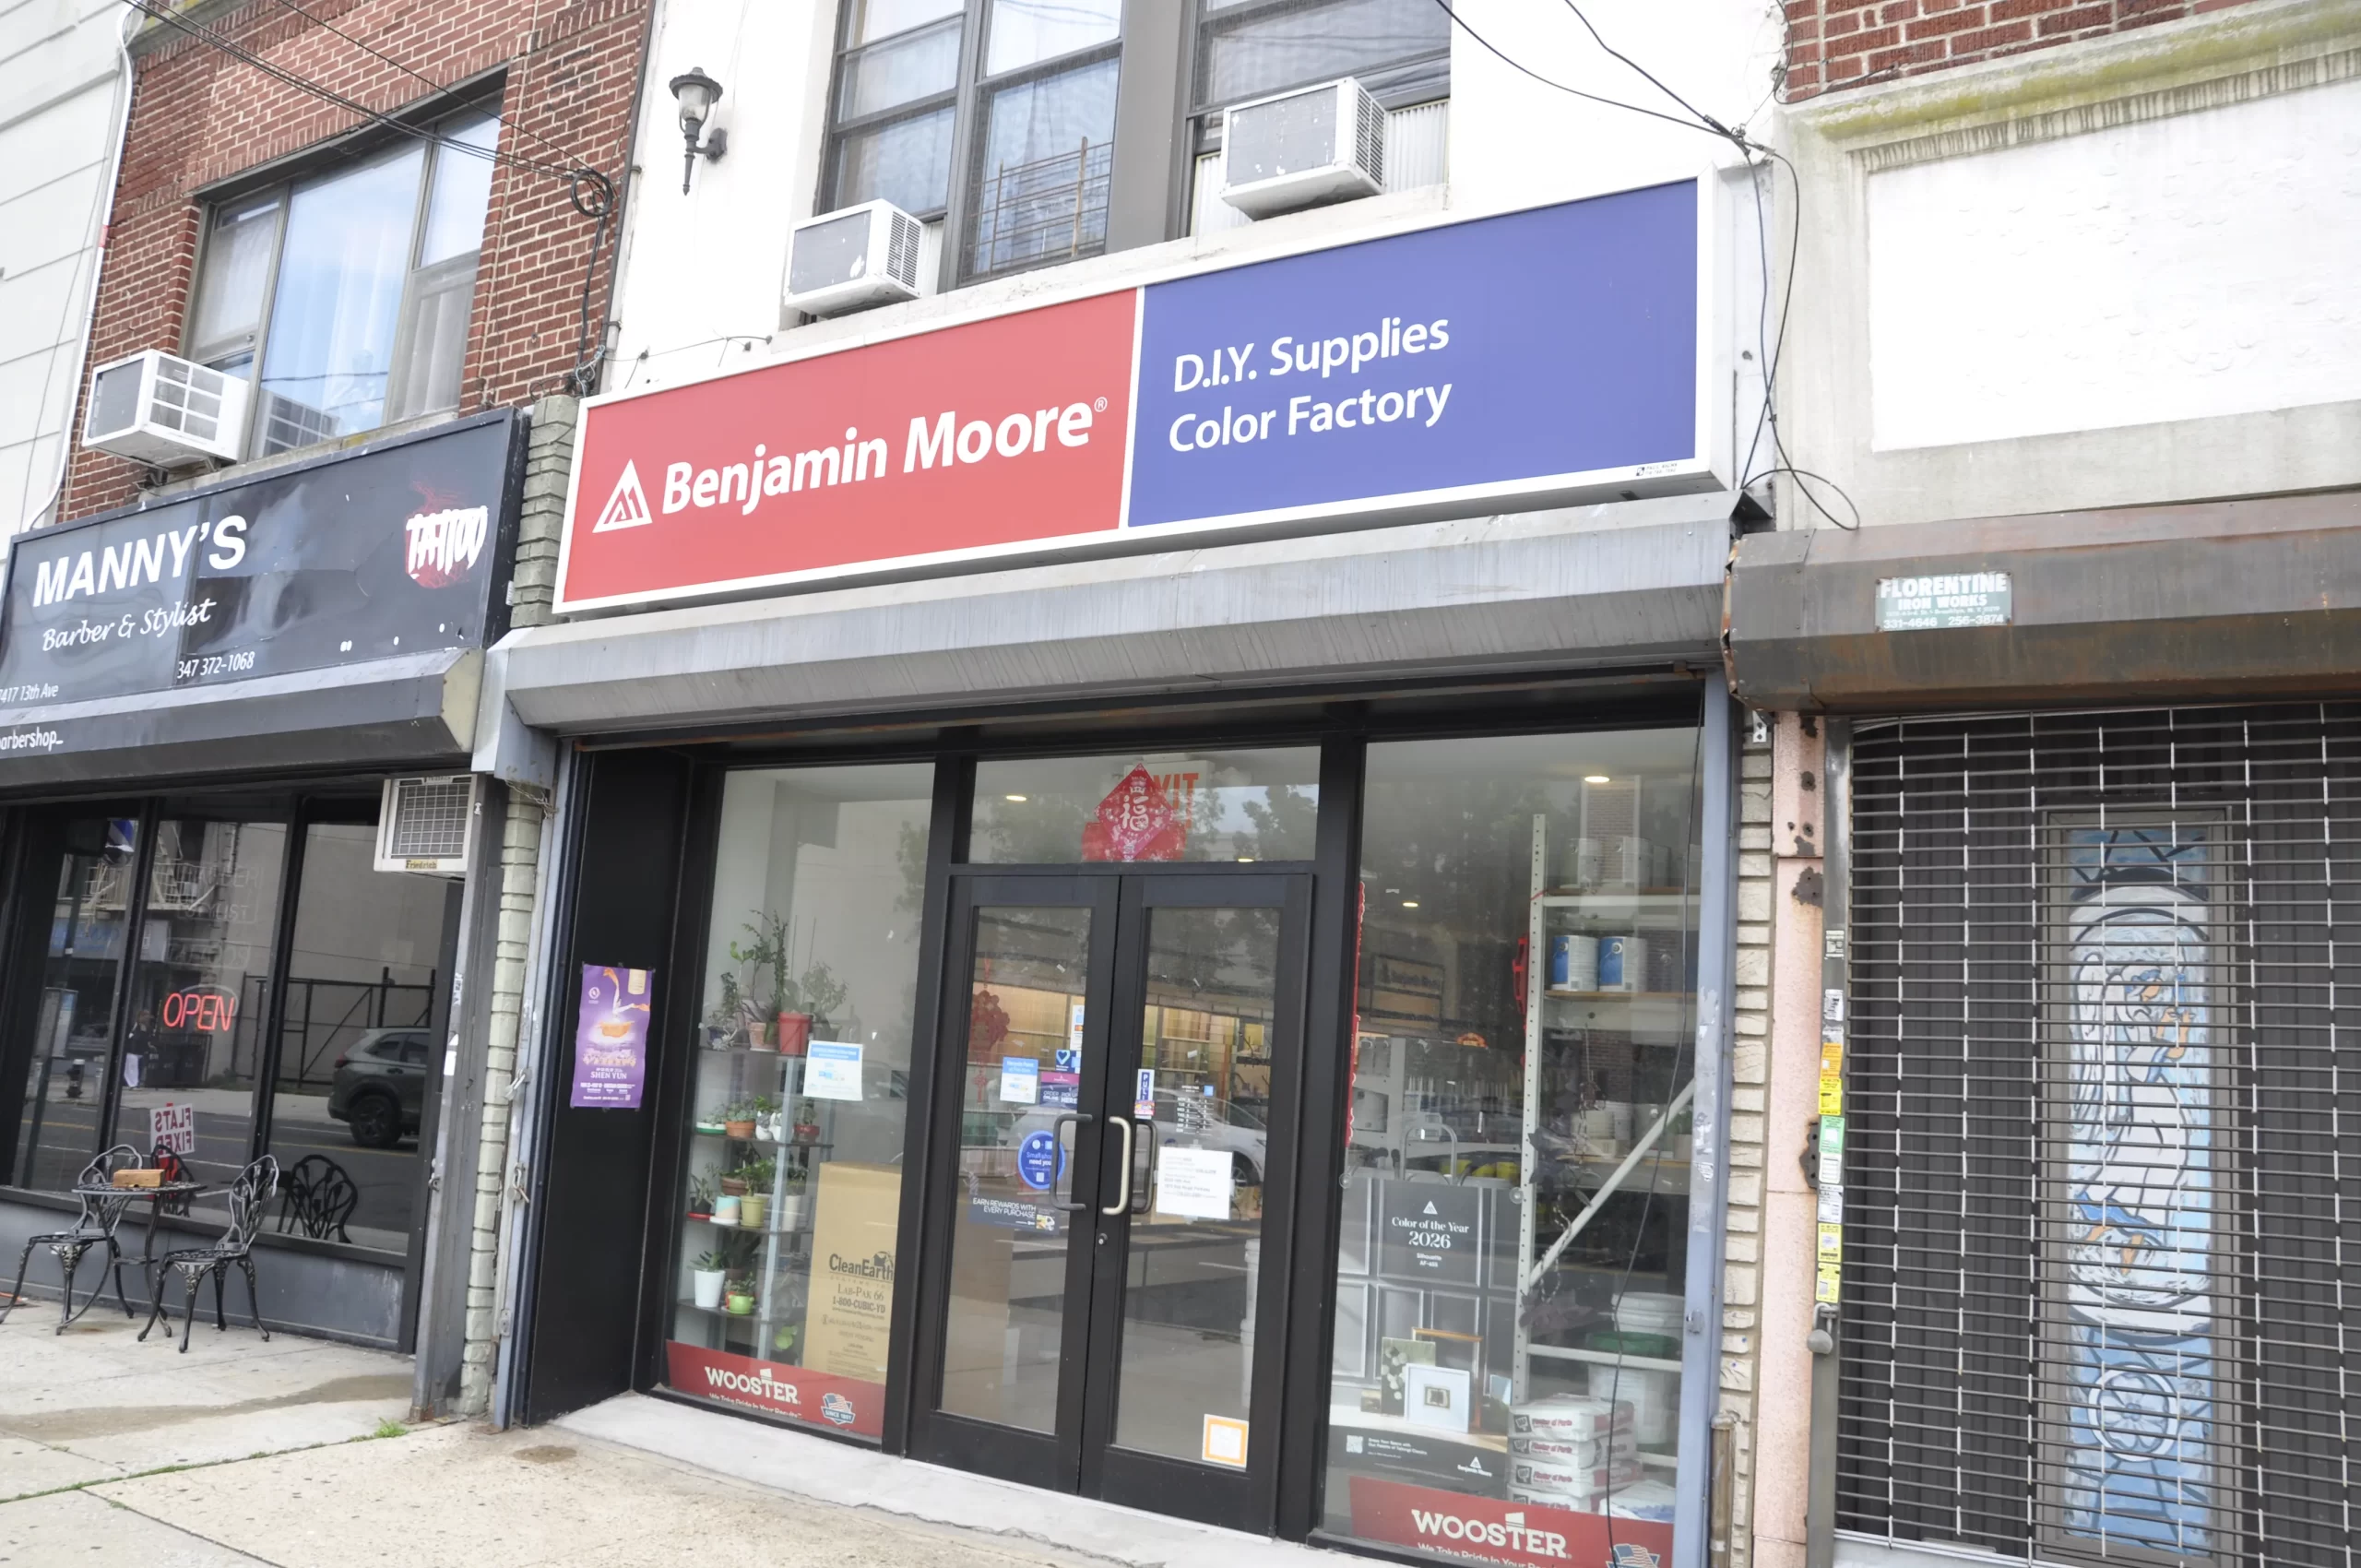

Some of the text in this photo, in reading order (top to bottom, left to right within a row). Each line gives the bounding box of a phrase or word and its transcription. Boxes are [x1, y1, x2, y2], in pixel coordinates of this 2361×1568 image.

[1173, 316, 1450, 393] D.I.Y. Supplies
[1169, 383, 1453, 453] Color Factory
[662, 427, 888, 515] Benjamin
[406, 505, 488, 577] TATTOO
[33, 515, 247, 608] MANNY'S
[1880, 572, 2008, 599] FLORENTINE
[1897, 594, 1987, 611] IRON WORKS
[42, 598, 218, 652] Barber & Stylist
[1883, 614, 2004, 629] 331-4646 256-3874
[176, 651, 255, 680] 347 372-1068
[19, 683, 40, 701] 13th
[40, 683, 59, 698] Ave
[0, 726, 64, 752] arbershop_
[163, 992, 235, 1031] OPEN
[590, 1071, 627, 1080] SHEN YUN
[972, 1197, 1037, 1211] EARN REWARDS WITH
[983, 1206, 1003, 1215] EVERY
[1003, 1206, 1036, 1218] PURCHASE
[1392, 1217, 1470, 1233] Color of the Year
[1408, 1230, 1452, 1249] 2026
[828, 1253, 894, 1281] CleanEarth
[832, 1295, 886, 1314] 1-800-CUBIC-YD
[873, 1290, 884, 1301] 66
[704, 1366, 799, 1405] WOOSTER
[825, 1409, 839, 1418] SINCE
[1411, 1509, 1567, 1559] WOOSTER
[1418, 1542, 1434, 1552] We
[1434, 1546, 1459, 1557] Take
[1462, 1550, 1489, 1562] Pride
